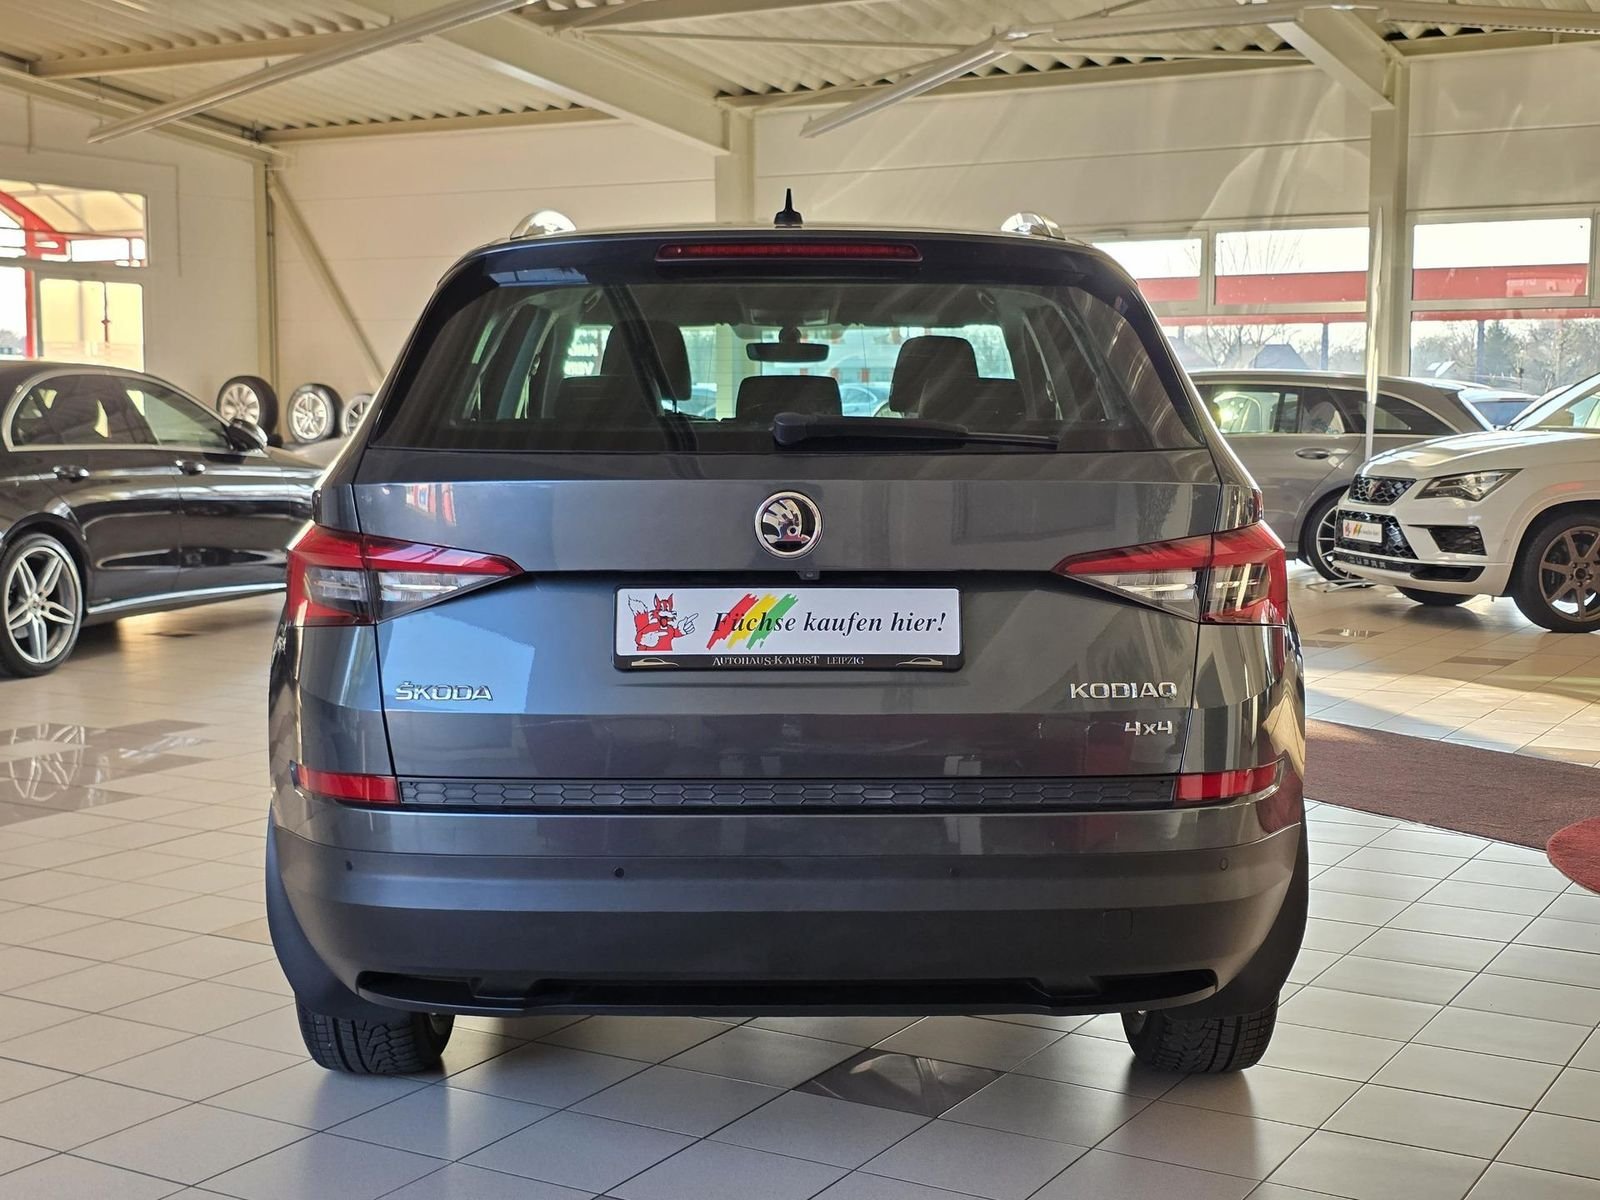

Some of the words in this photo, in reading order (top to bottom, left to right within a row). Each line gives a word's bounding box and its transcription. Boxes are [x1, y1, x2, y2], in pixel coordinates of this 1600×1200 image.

[712, 612, 797, 632] Füchse
[803, 611, 883, 637] kaufen
[890, 612, 946, 632] hier!
[826, 656, 864, 665] LEIPZIG
[395, 681, 493, 701] ŠKODA
[1070, 682, 1178, 700] KODIAQ
[1124, 720, 1173, 736] 4x4
